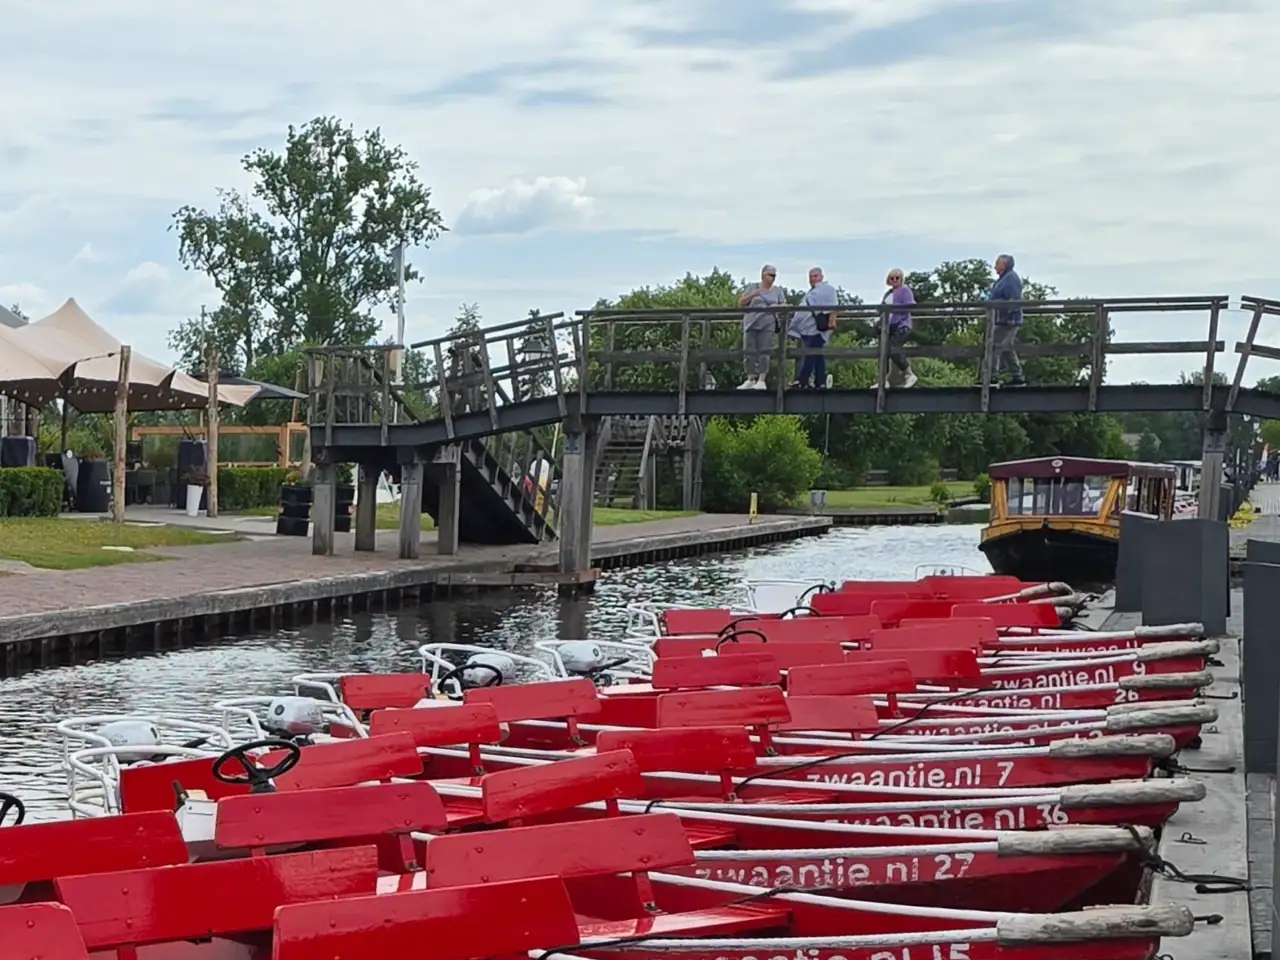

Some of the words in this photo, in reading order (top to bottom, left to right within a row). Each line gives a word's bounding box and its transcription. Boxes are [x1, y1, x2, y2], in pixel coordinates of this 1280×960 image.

[1115, 689, 1139, 703] 26
[997, 761, 1014, 786] 7
[1036, 804, 1069, 824] 36
[934, 853, 975, 881] 27
